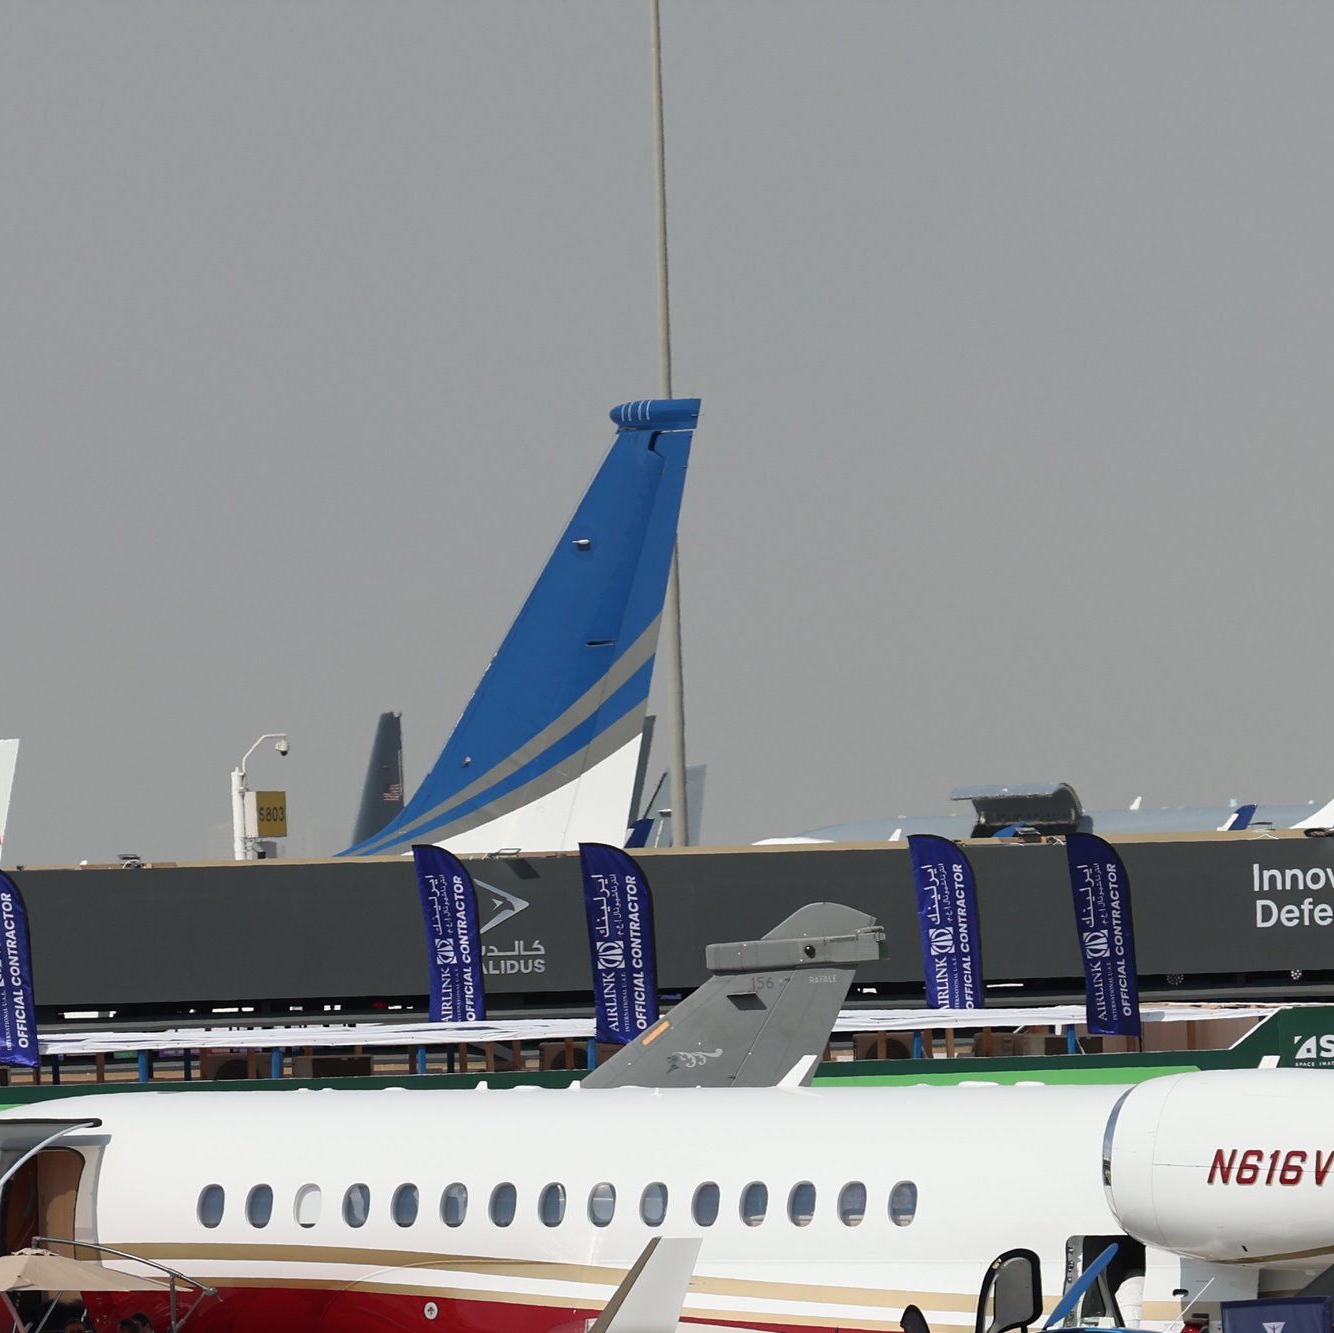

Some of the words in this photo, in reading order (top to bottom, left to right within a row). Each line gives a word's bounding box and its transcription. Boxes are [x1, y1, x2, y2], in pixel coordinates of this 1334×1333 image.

[259, 807, 285, 822] S803
[452, 875, 471, 963] CONTRACTOR
[624, 875, 643, 969] CONTRACTOR
[952, 864, 971, 952] CONTRACTOR
[1106, 863, 1125, 956] CONTRACTOR
[0, 892, 22, 987] CONTRACTOR
[481, 959, 546, 975] ALIDUS
[440, 967, 455, 1022] AIRLINK
[464, 967, 476, 1021] OFFICIAL
[602, 971, 620, 1032] AIRLINK
[634, 971, 647, 1030] OFFICIAL
[808, 975, 839, 984] RAFALE
[964, 956, 975, 1009] OFFICIAL
[1090, 961, 1108, 1021] AIRLINK
[1117, 959, 1132, 1016] OFFICIAL
[13, 989, 29, 1049] OFFICIAL
